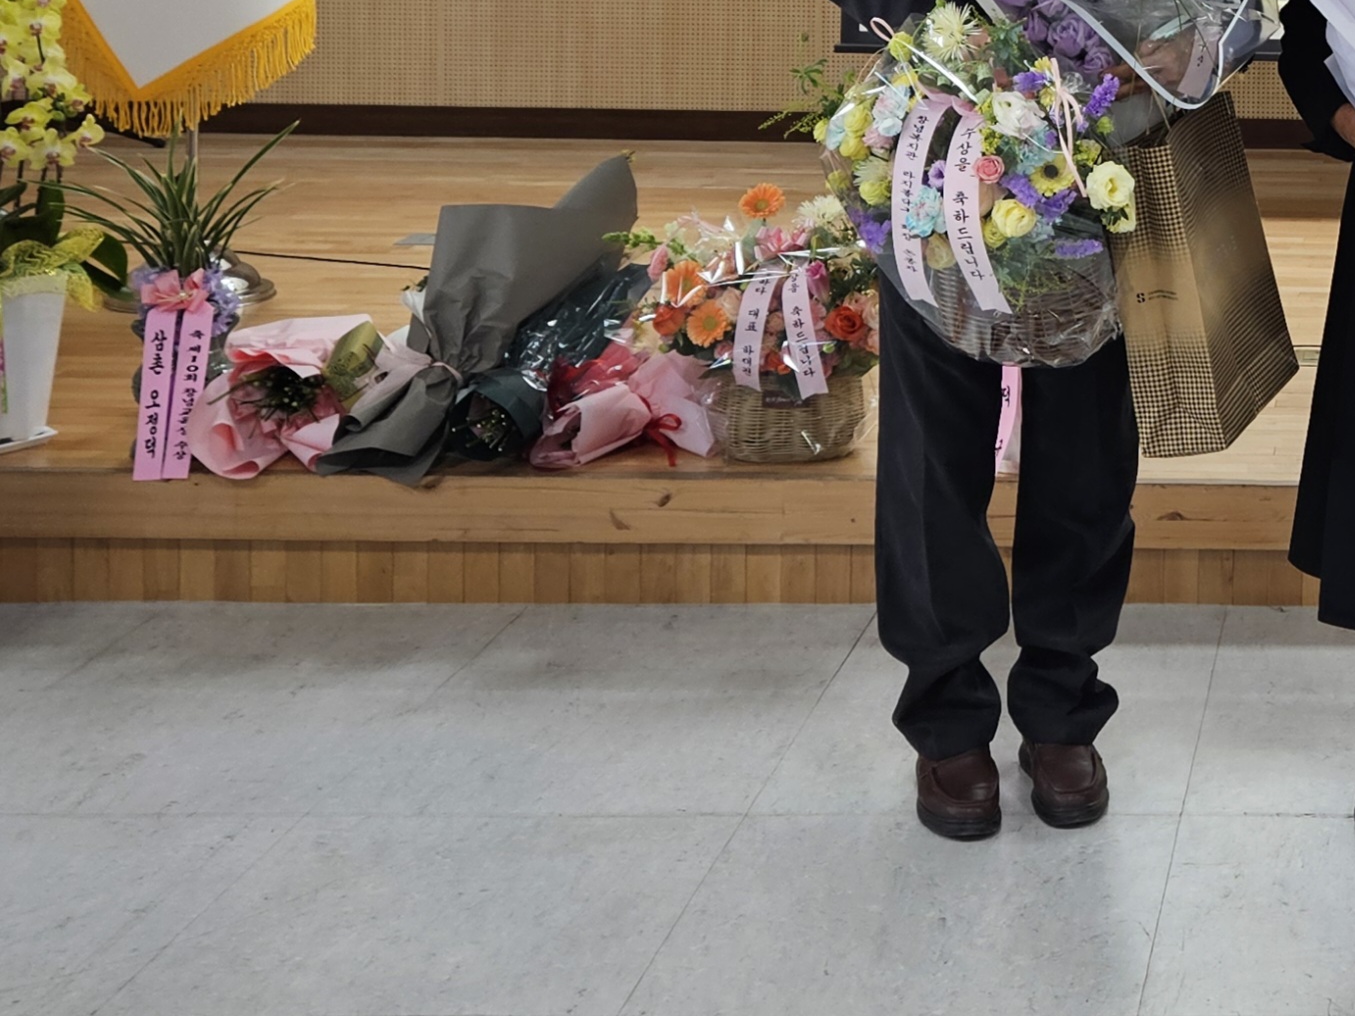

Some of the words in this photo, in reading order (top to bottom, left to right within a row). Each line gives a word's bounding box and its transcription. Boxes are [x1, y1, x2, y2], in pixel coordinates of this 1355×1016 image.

[955, 128, 976, 172] 수상을
[952, 191, 985, 281] 축하드립니다
[148, 329, 168, 375] 삼촌
